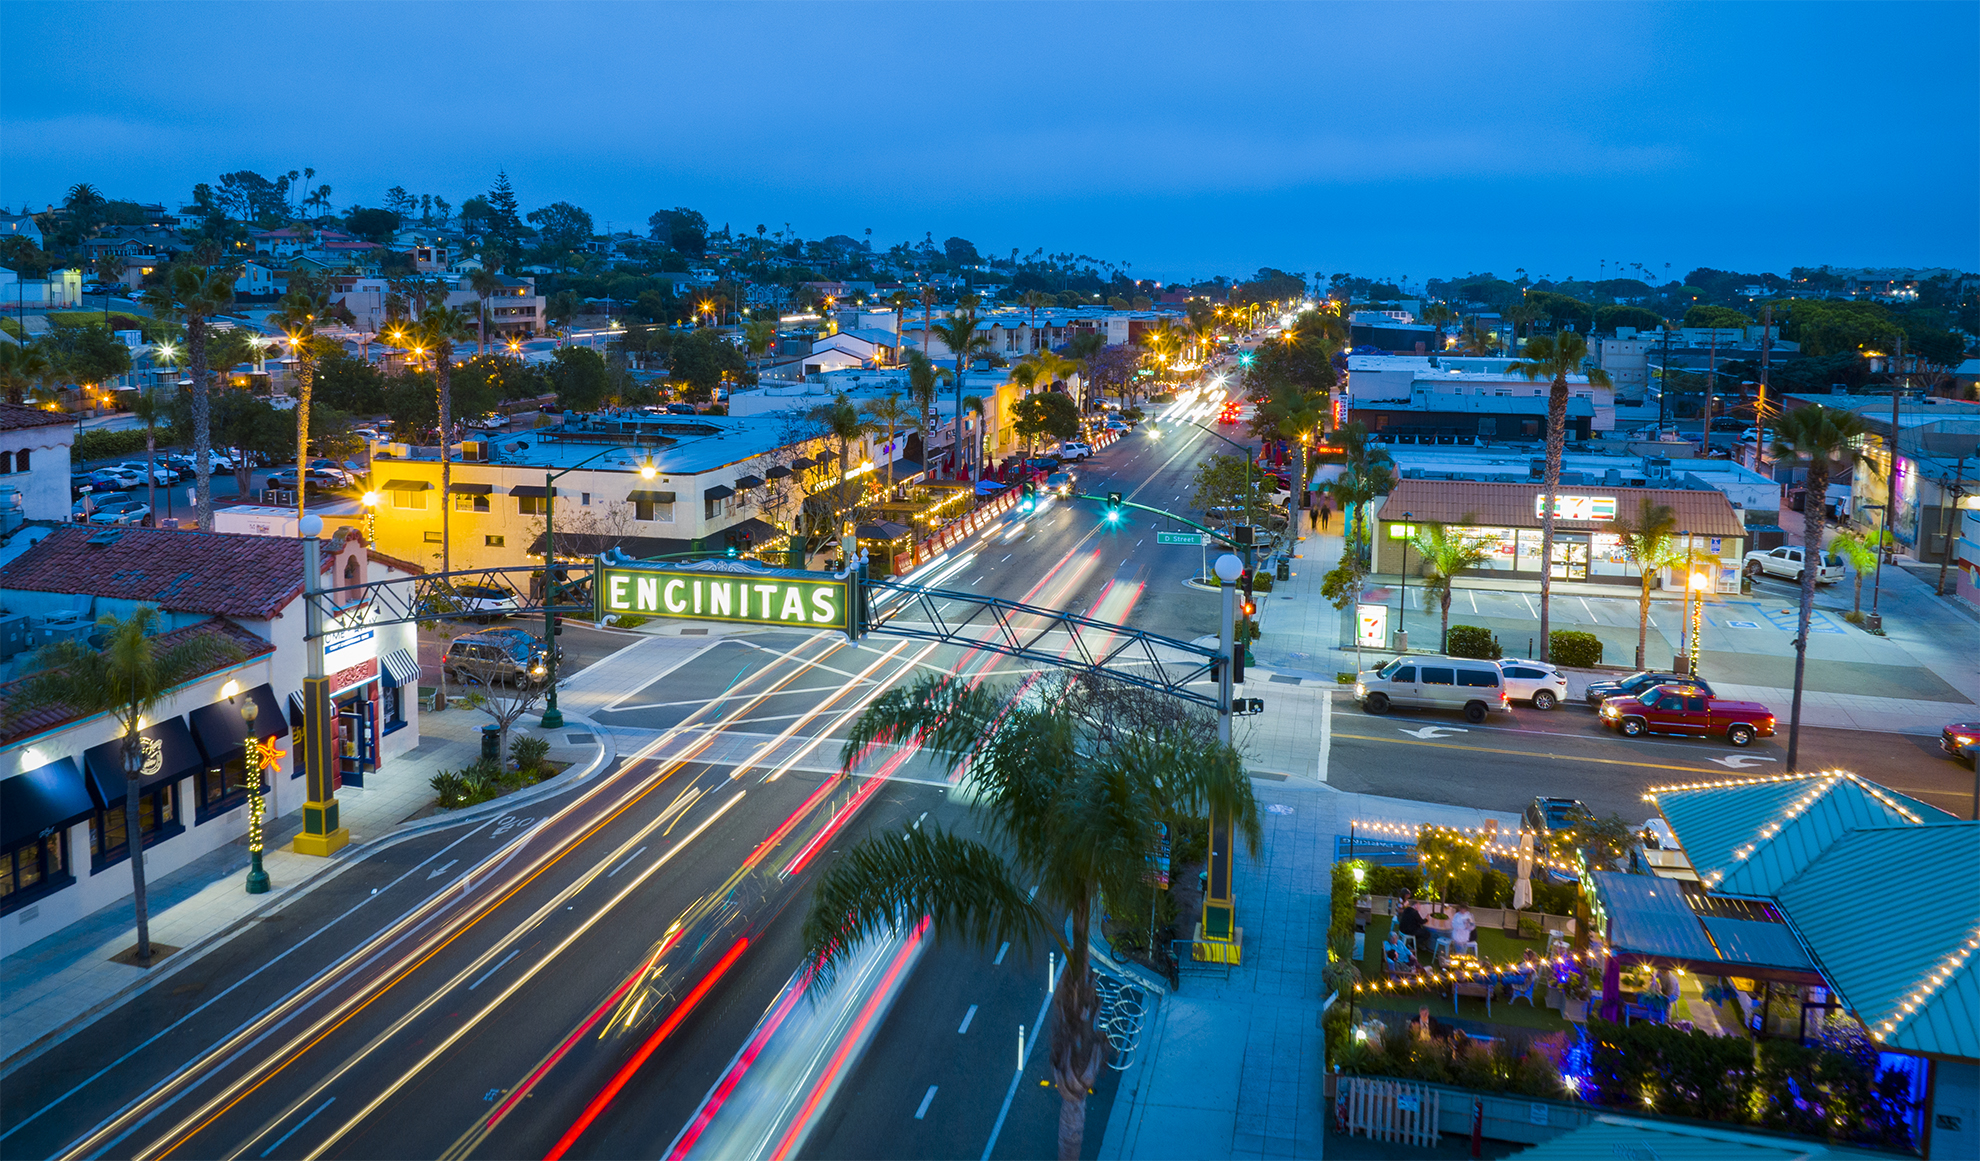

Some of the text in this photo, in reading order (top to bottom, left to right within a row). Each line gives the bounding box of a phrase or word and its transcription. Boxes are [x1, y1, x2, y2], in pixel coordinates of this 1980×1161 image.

[1172, 535, 1195, 543] Street
[609, 575, 836, 623] ENCINITAS
[1363, 617, 1379, 638] 7
[1342, 838, 1394, 849] PARKING
